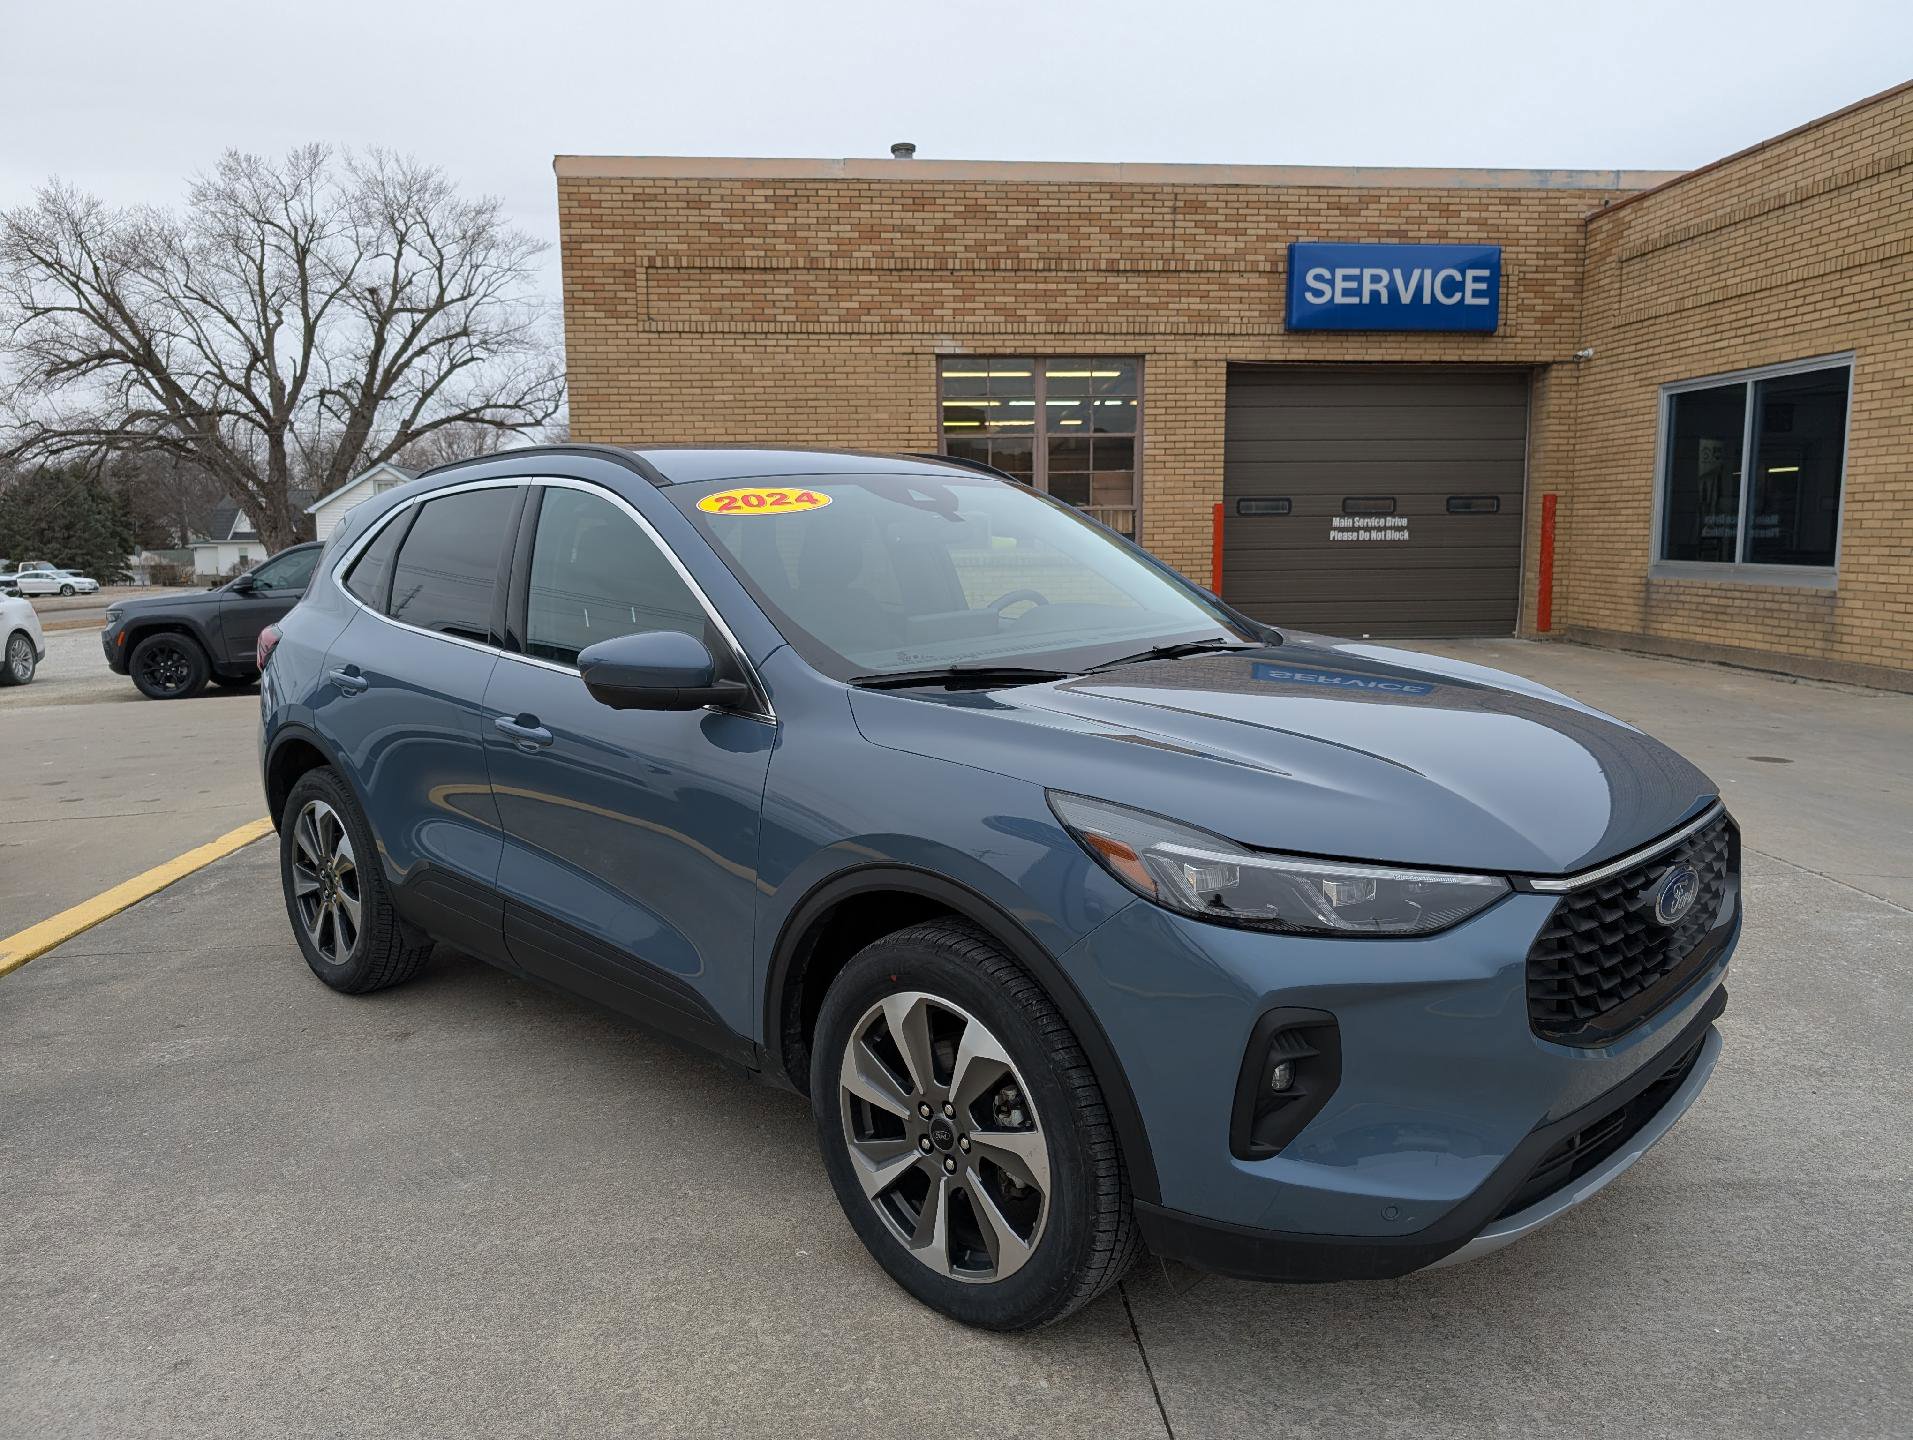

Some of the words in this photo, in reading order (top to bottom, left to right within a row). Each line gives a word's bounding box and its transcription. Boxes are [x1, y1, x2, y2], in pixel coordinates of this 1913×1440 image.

[1304, 267, 1491, 305] SERVICE
[714, 491, 821, 513] 2024
[1332, 516, 1353, 528] Main
[1354, 516, 1385, 528] Service
[1386, 516, 1408, 527] Drive
[1329, 529, 1358, 541] Please
[1359, 529, 1370, 541] Do
[1371, 529, 1385, 541] Not
[1386, 529, 1409, 541] Block
[1670, 878, 1697, 914] Ford
